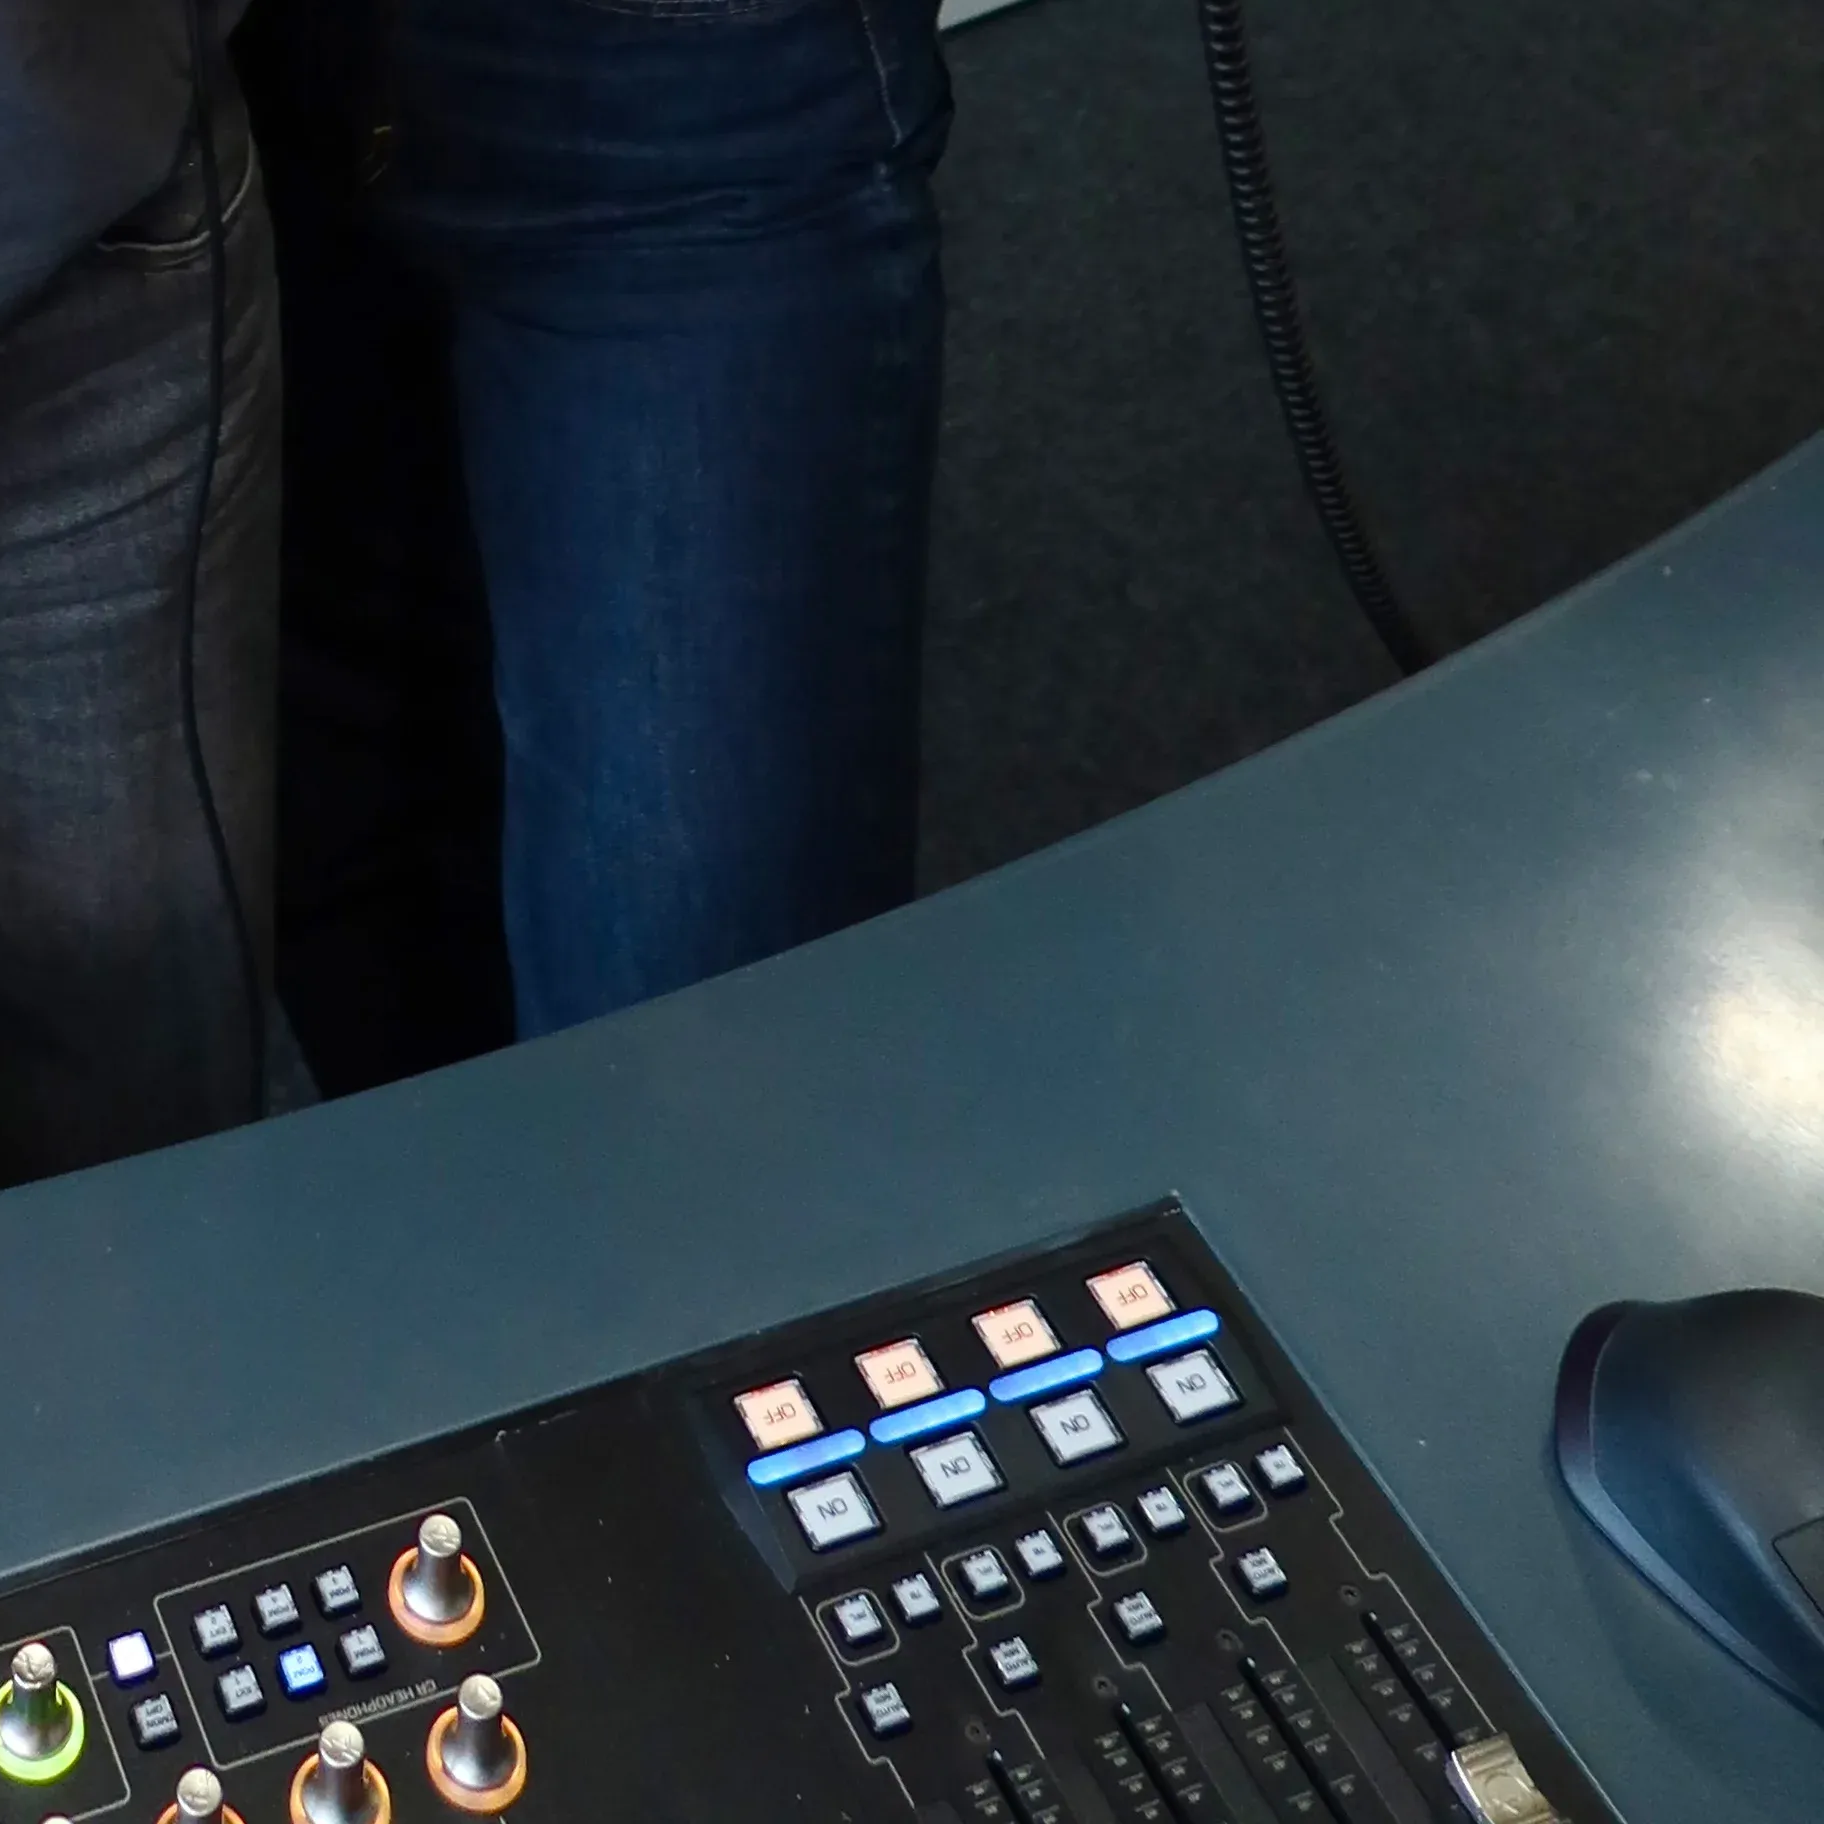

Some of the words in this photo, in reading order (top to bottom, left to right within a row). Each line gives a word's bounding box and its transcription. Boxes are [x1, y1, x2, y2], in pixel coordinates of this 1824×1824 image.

[1117, 1283, 1149, 1306] OFF
[1002, 1321, 1034, 1344] OFF
[884, 1361, 916, 1384] OFF
[1175, 1372, 1206, 1395] ON
[763, 1402, 797, 1424] OFF
[1059, 1413, 1091, 1436] ON
[939, 1455, 971, 1479] ON
[816, 1496, 849, 1520] ON
[419, 1678, 438, 1696] CR
